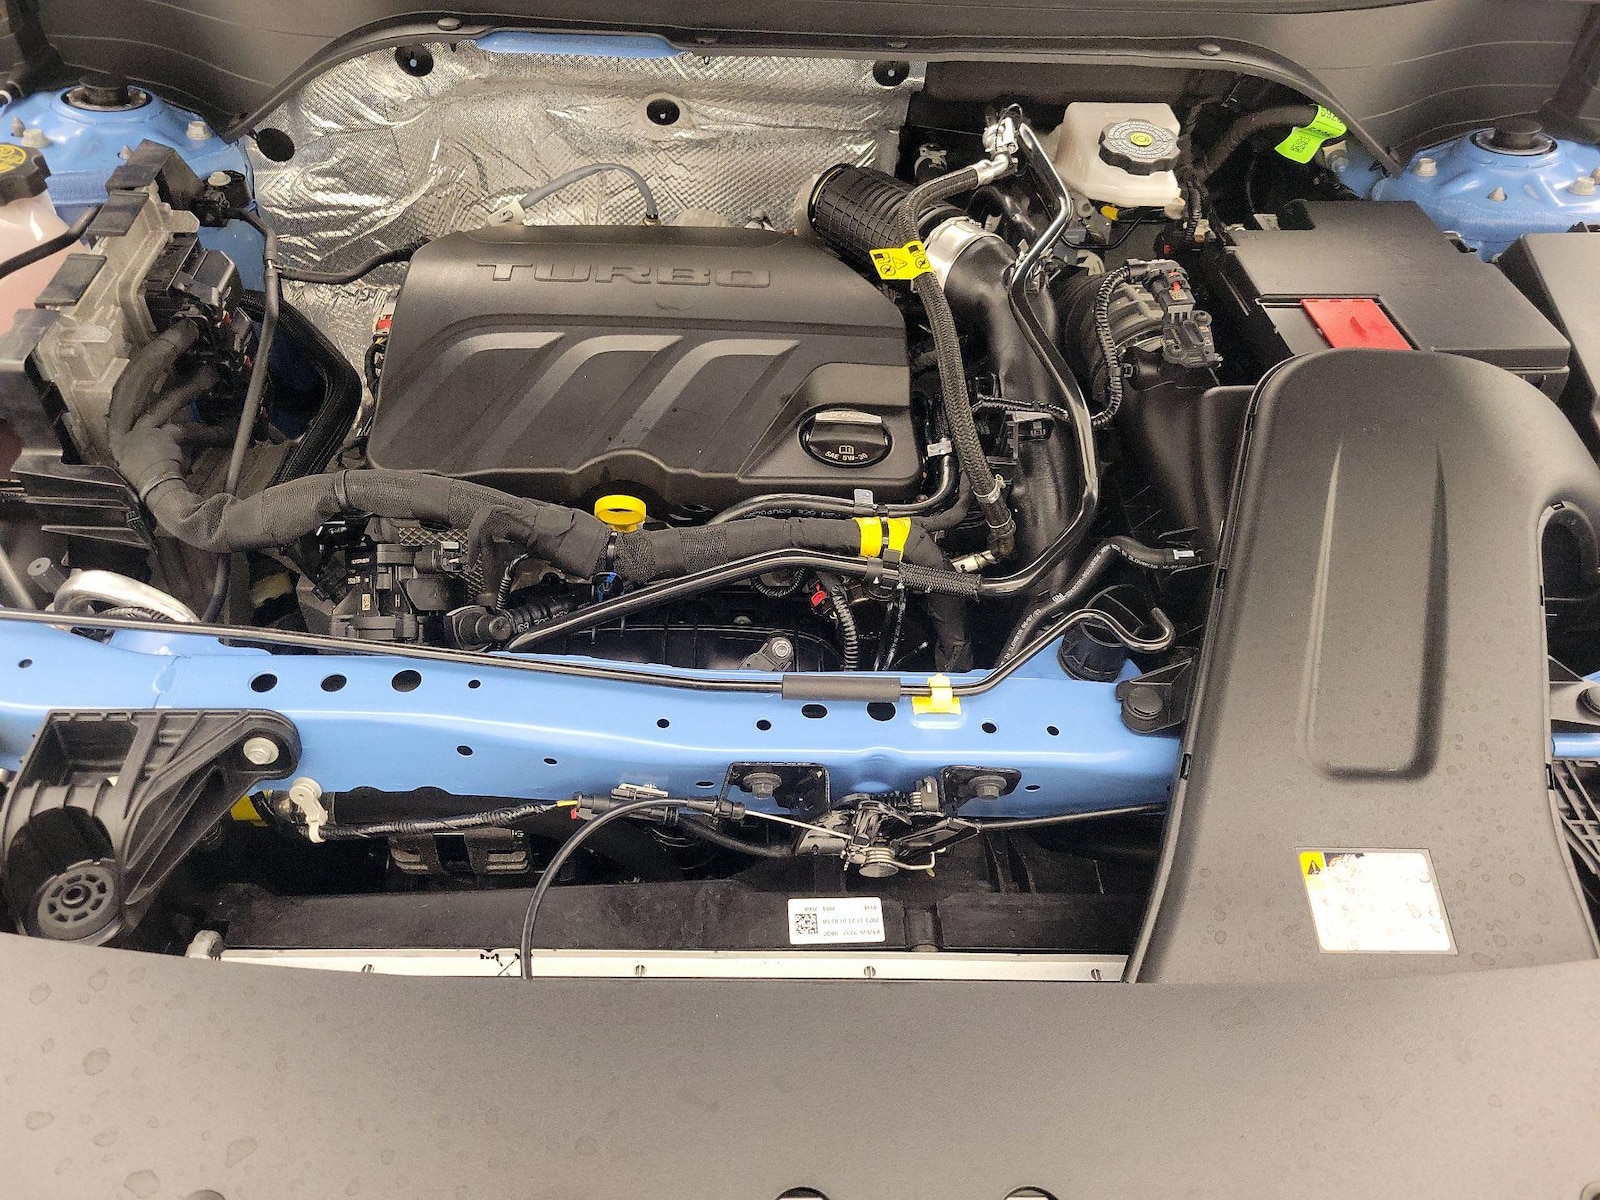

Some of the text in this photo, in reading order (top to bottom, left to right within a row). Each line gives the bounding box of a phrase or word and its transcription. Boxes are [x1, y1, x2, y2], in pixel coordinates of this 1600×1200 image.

[476, 262, 771, 289] TURBO
[825, 450, 868, 461] SAE 5W-30
